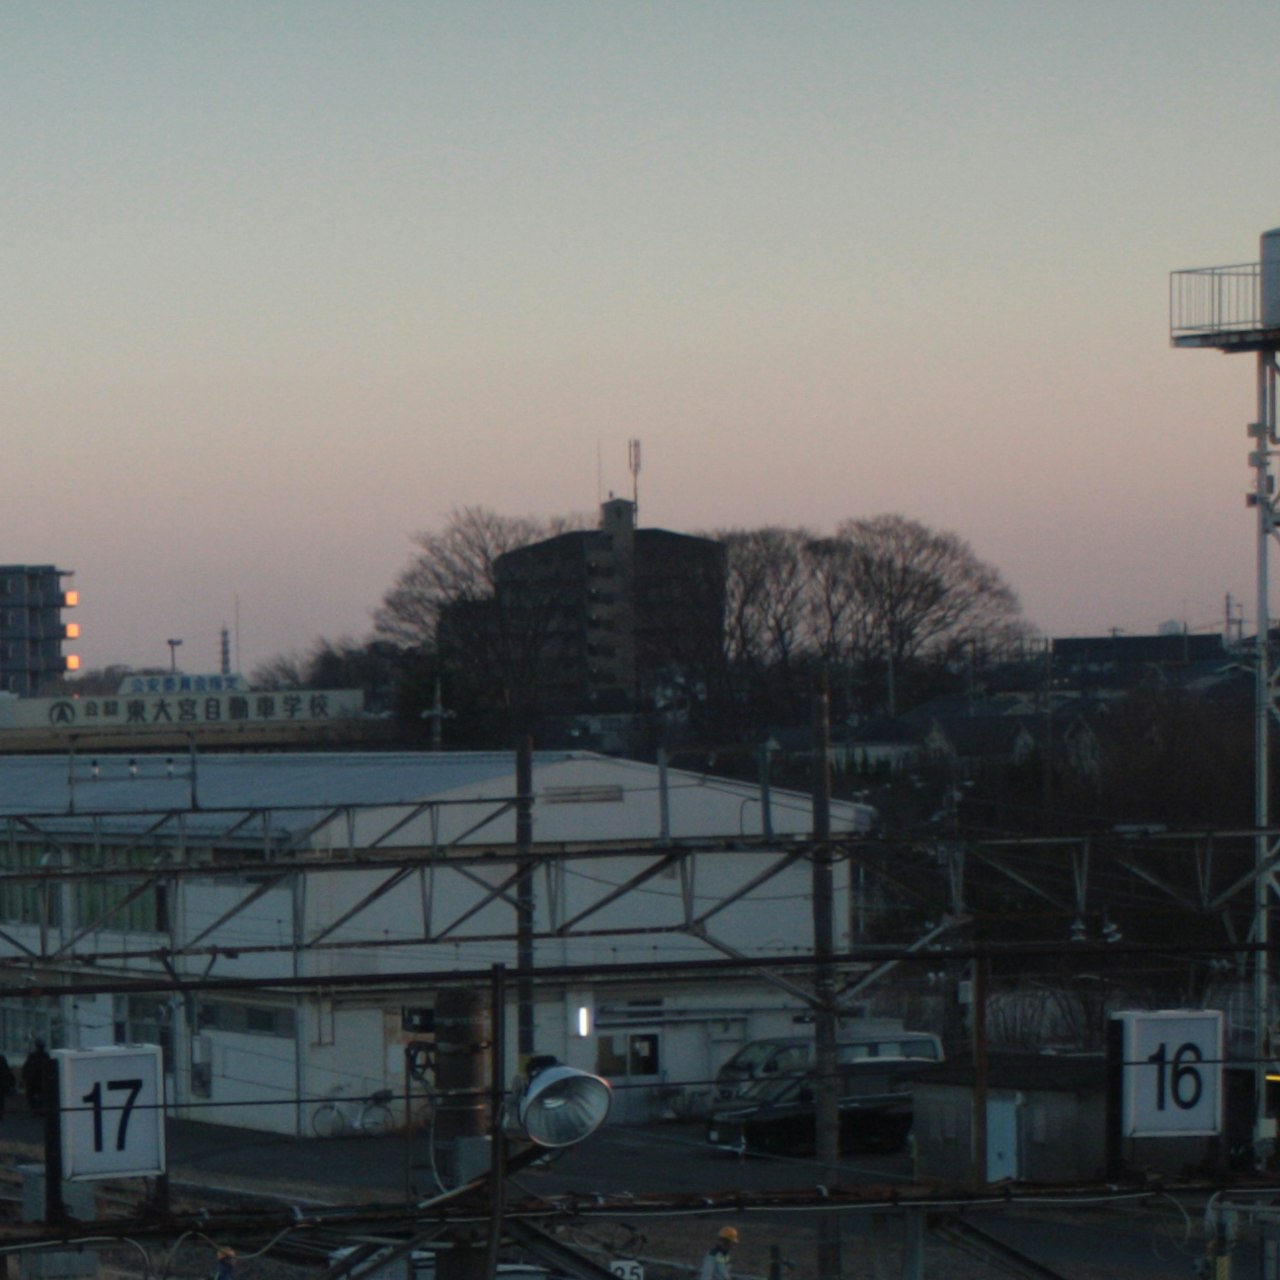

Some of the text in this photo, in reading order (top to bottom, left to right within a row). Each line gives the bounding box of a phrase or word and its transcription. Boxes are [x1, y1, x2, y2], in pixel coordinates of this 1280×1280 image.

[126, 694, 330, 724] 東大宮自動車学校
[1146, 1043, 1203, 1111] 16
[81, 1078, 144, 1153] 17
